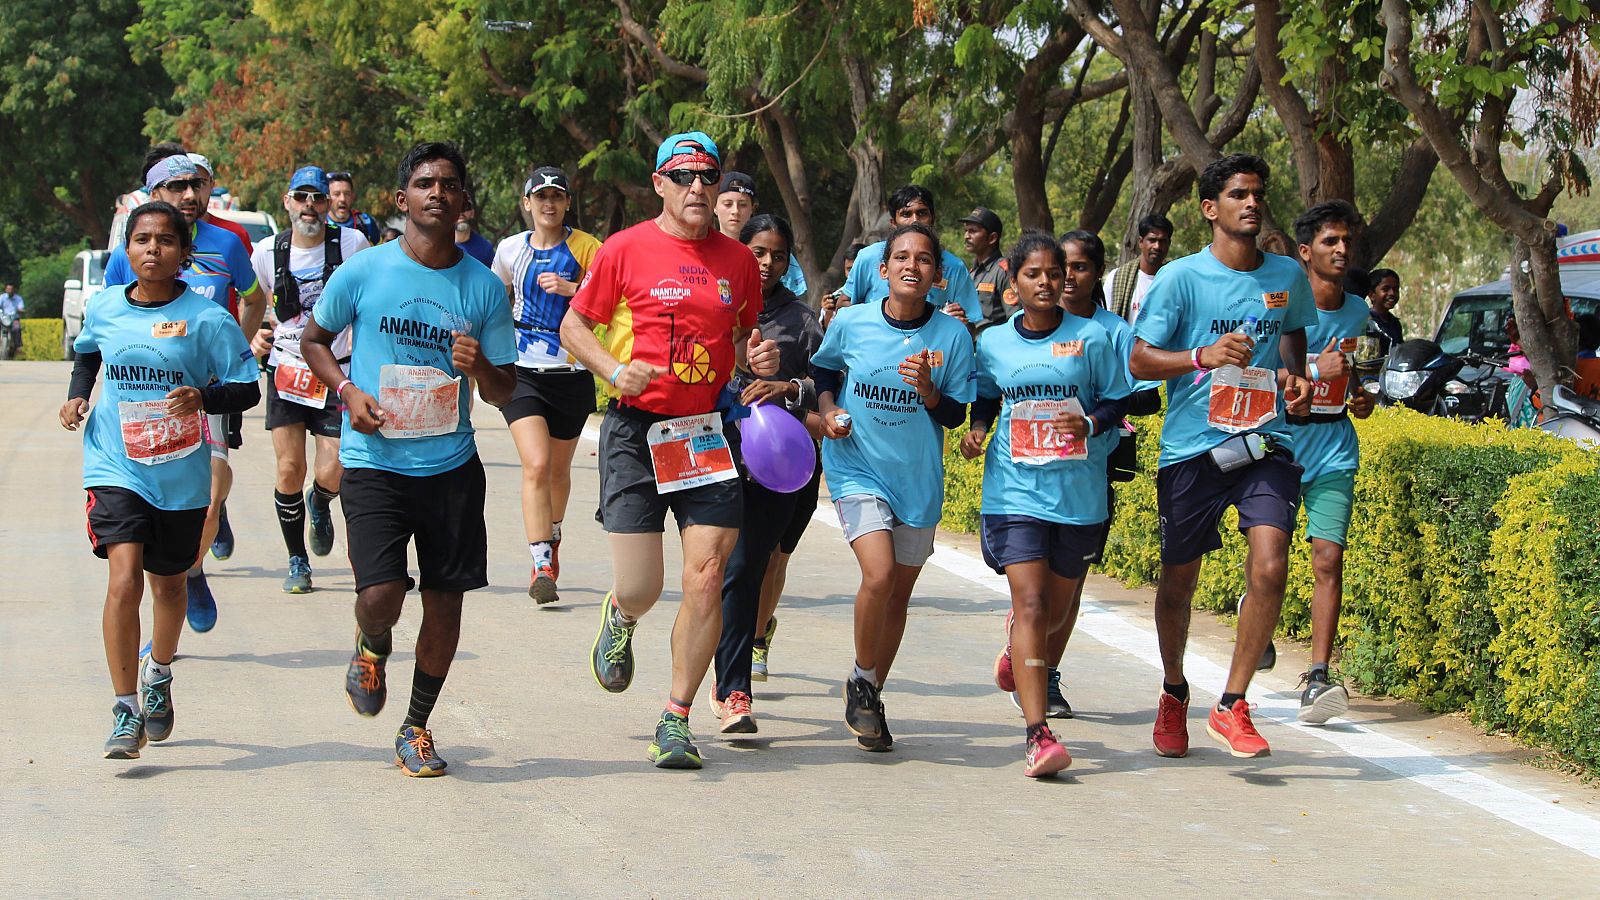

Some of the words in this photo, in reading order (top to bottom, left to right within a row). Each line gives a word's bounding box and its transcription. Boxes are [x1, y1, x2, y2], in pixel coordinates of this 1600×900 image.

[679, 265, 709, 275] INDIA
[683, 275, 708, 286] 2019
[650, 287, 691, 297] ANANTAPUR
[413, 297, 444, 311] DEVELOPMENT
[379, 316, 456, 348] ANANTAPU
[1210, 319, 1281, 335] ANAAPUR
[128, 343, 157, 353] DEVELOPMENT
[396, 336, 449, 354] ULTRAMARATHON
[105, 363, 184, 386] ANANTAPUR
[293, 369, 312, 390] 15
[117, 382, 171, 393] ULTRAMARATHON
[853, 381, 926, 406] ANANTAPU
[866, 400, 918, 413] ULTRAMARATHON
[1231, 391, 1252, 418] 81
[671, 417, 705, 427] ANANTAPUR
[684, 441, 698, 468] 1
